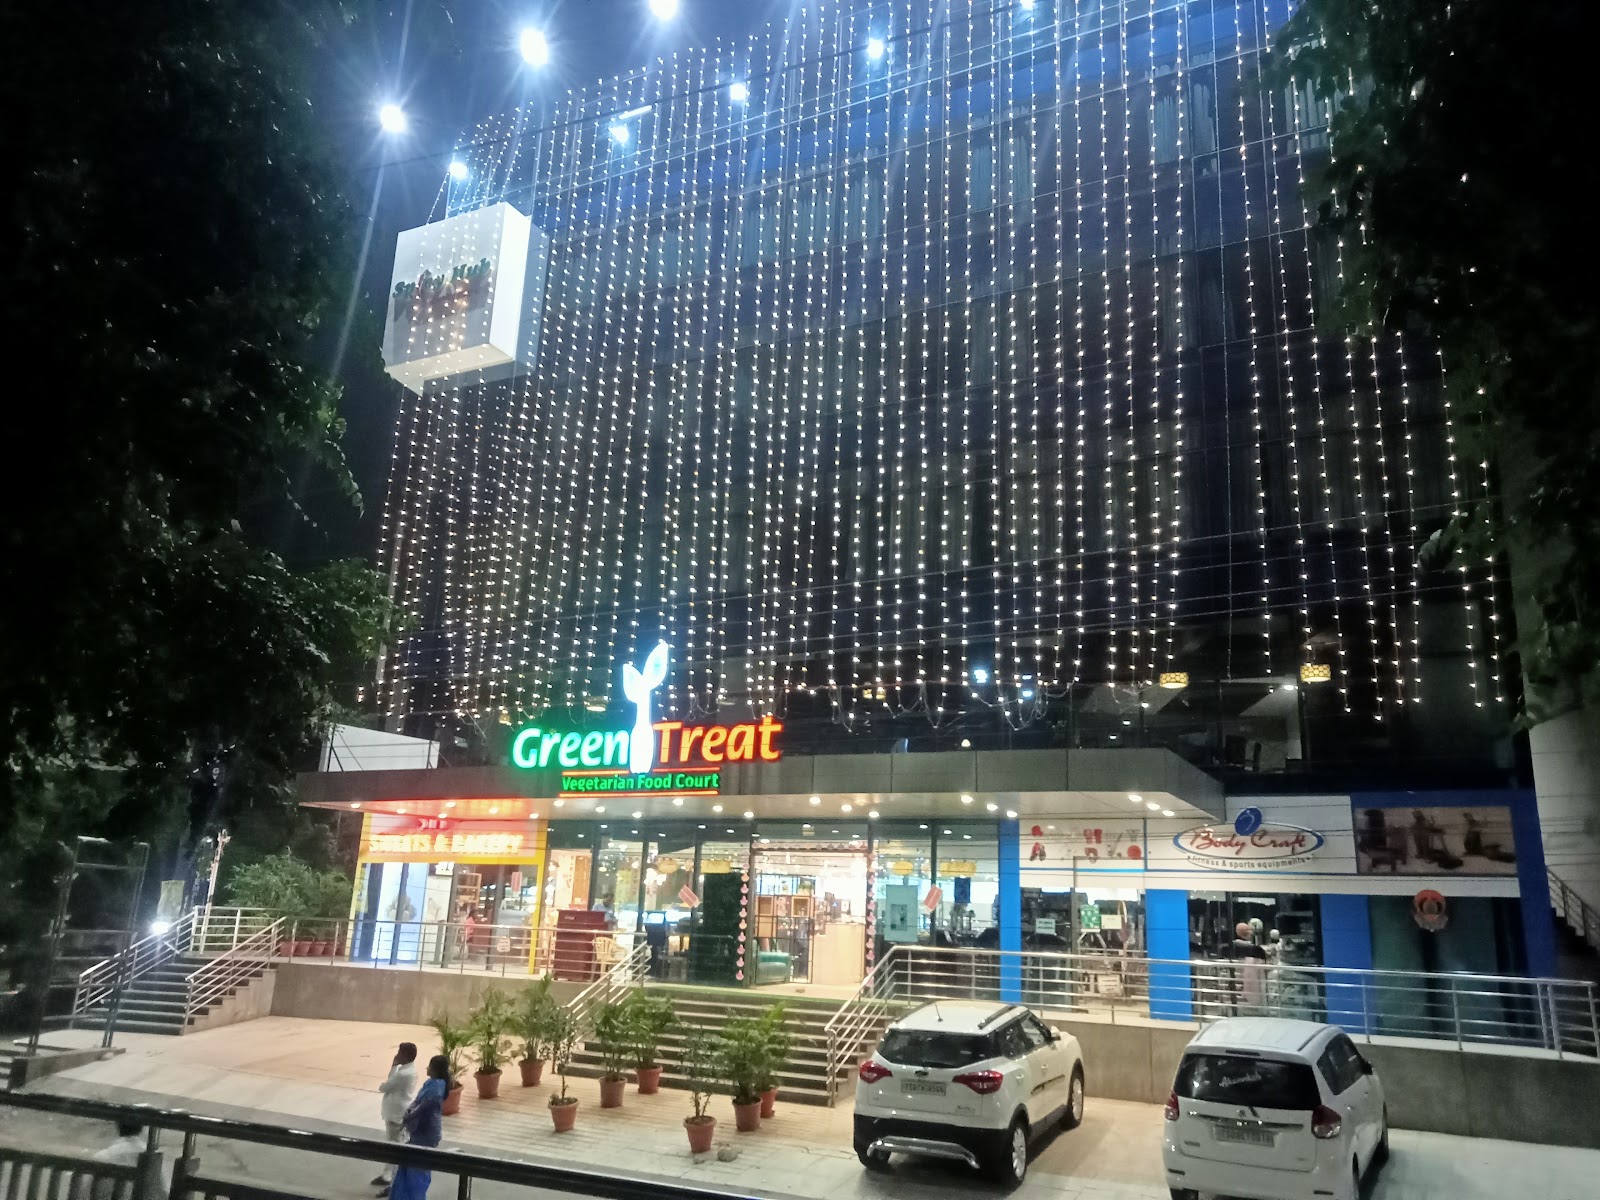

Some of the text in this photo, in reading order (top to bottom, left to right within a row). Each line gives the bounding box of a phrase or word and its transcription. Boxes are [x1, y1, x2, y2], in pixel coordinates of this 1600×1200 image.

[511, 716, 782, 769] Green Treat
[562, 772, 720, 792] Vegetarian Food Court
[452, 833, 524, 855] BAKERY
[1190, 828, 1306, 855] Body Craft
[1229, 860, 1255, 870] sports
